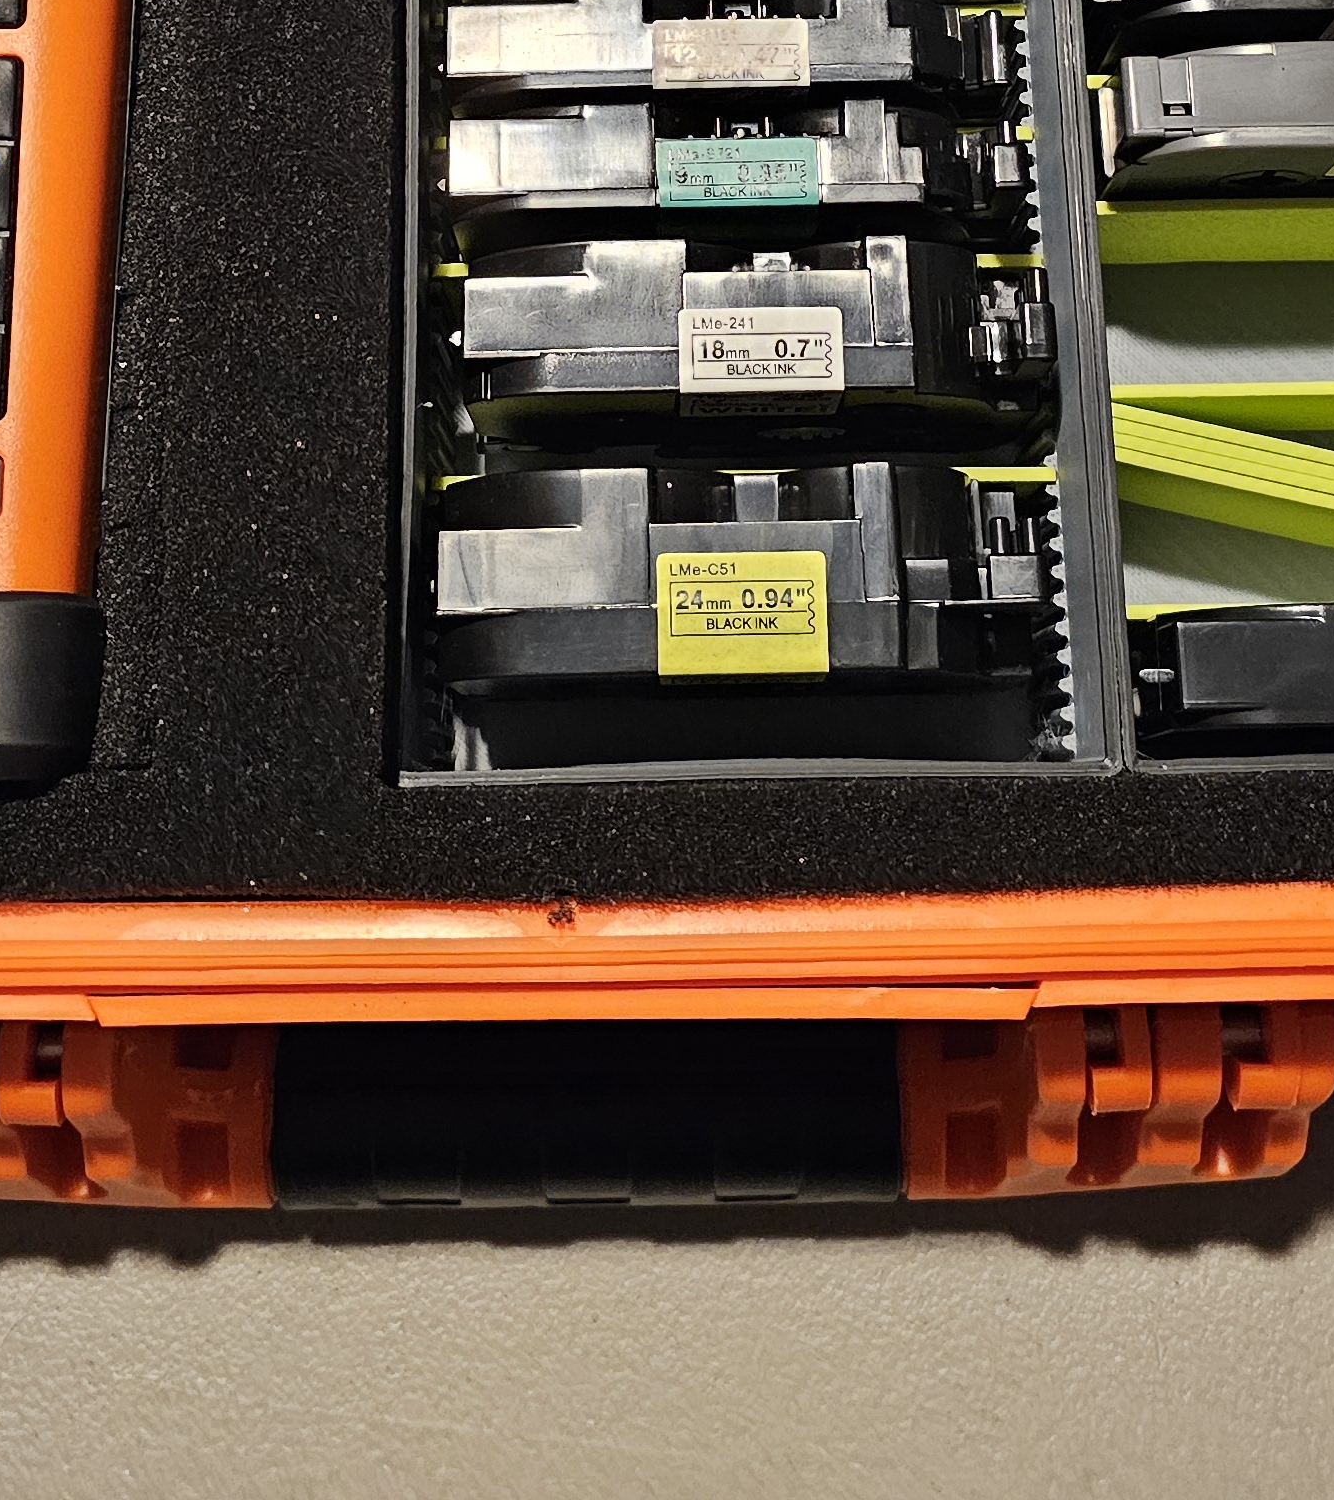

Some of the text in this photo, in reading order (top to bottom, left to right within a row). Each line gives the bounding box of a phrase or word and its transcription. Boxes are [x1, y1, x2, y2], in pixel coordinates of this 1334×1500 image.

[704, 187, 746, 197] BLACK
[692, 317, 754, 329] LMe-241
[727, 364, 796, 375] BLACK INK
[670, 563, 737, 576] LMe-C51
[707, 617, 778, 630] BLACK INK
